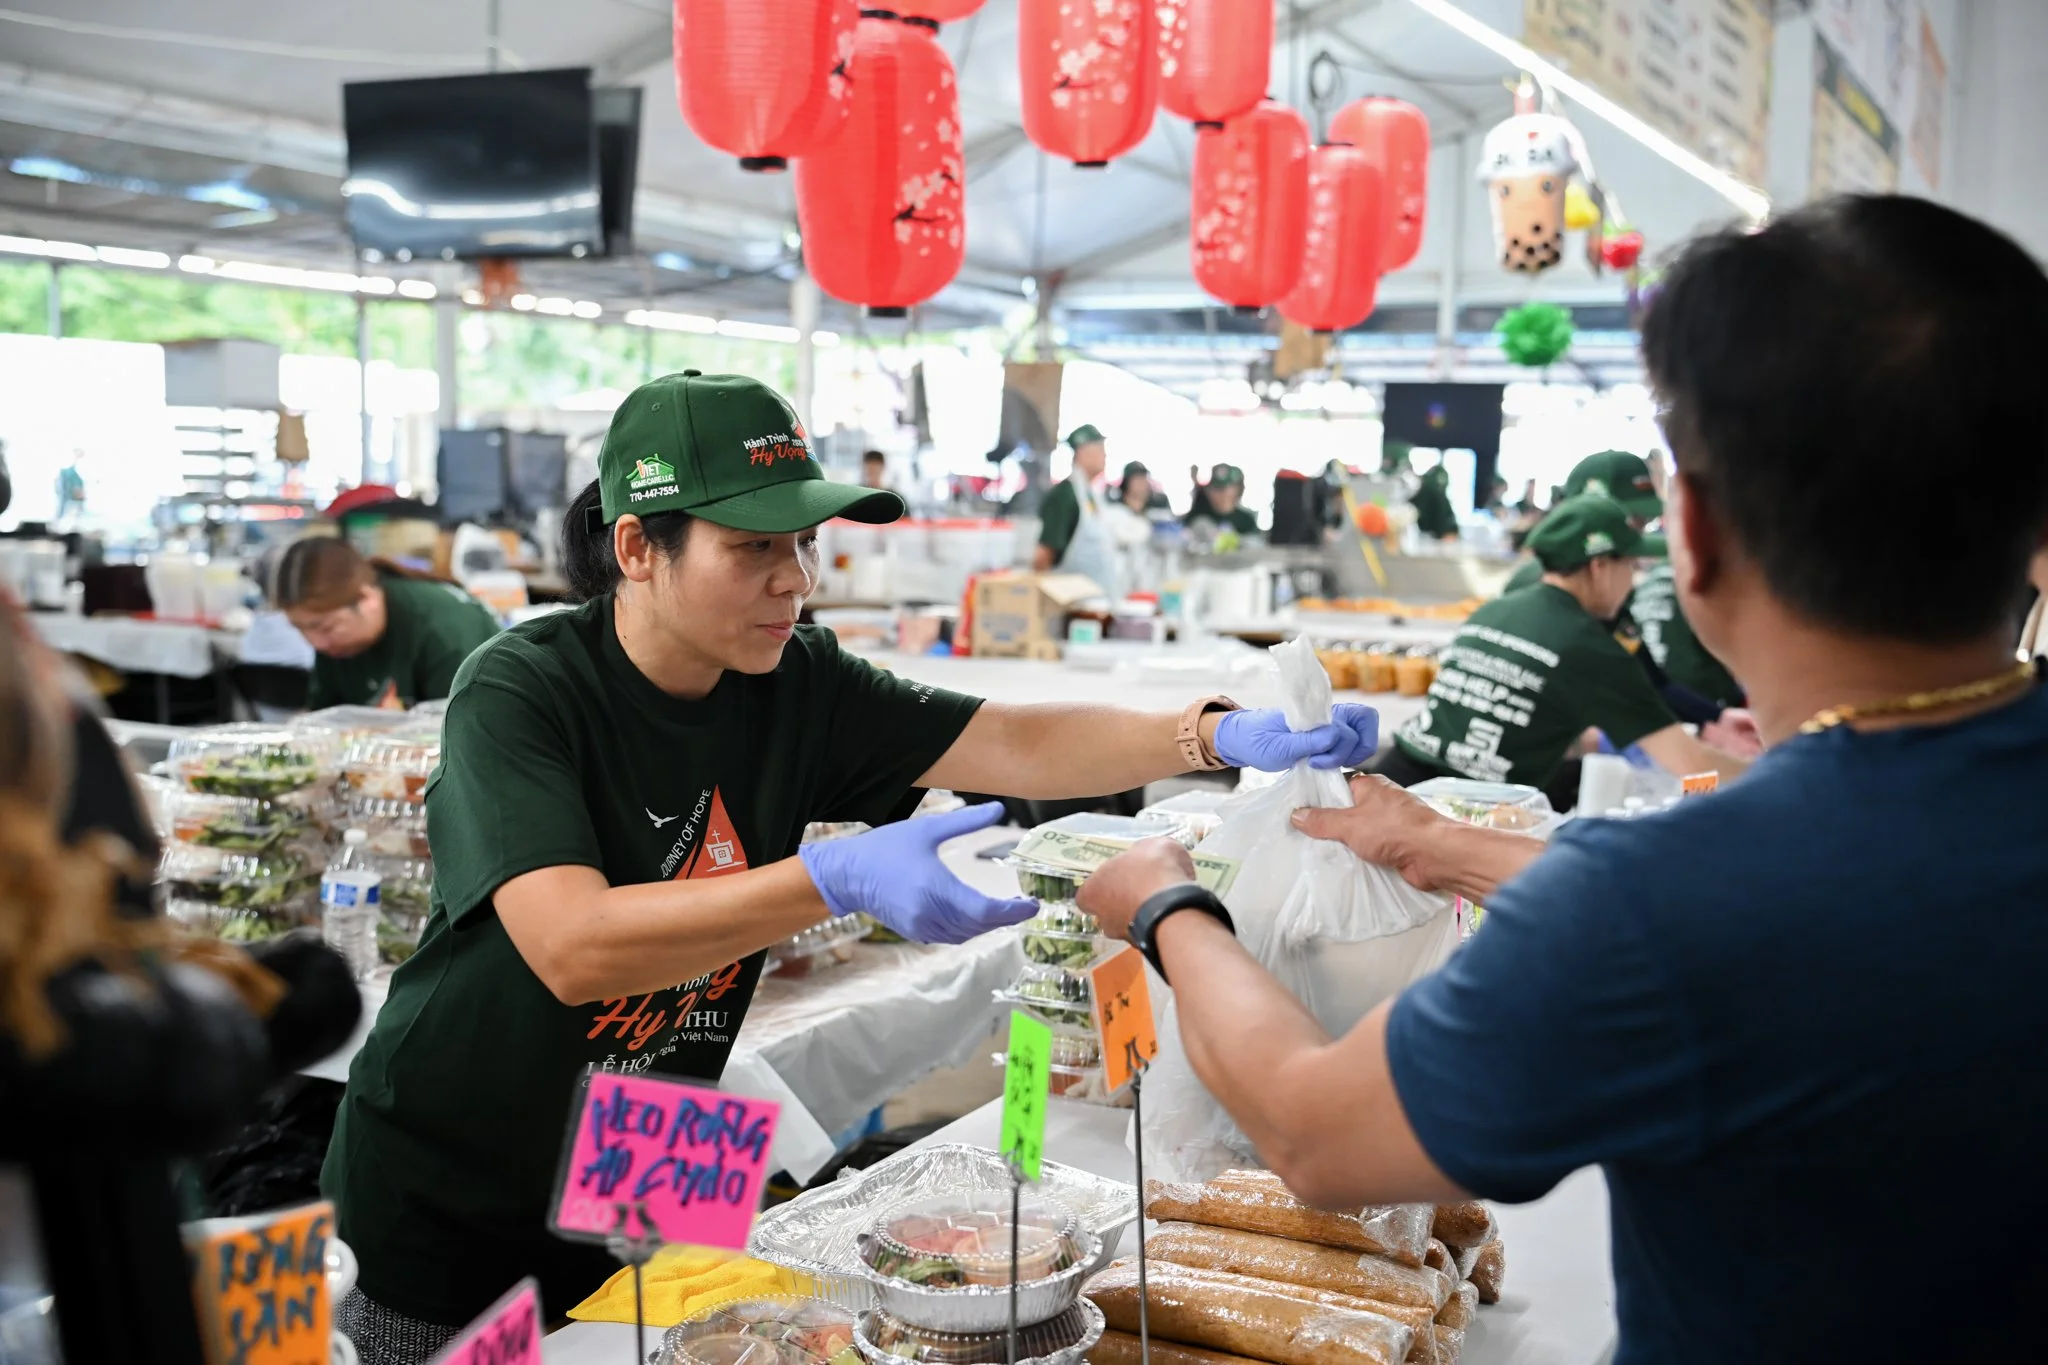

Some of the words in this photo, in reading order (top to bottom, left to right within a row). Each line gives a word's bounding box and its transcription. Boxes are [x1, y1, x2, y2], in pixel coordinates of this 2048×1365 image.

[750, 446, 775, 467] Hy
[636, 459, 660, 478] VIET
[629, 485, 680, 502] 770-447-7554
[660, 838, 687, 878] JOURNEY
[681, 822, 695, 841] OF
[690, 789, 711, 823] HOPE
[1043, 830, 1071, 845] 20
[586, 993, 667, 1051] Hy
[684, 1010, 729, 1028] THU
[681, 1031, 701, 1043] Việt
[704, 1032, 729, 1042] Nam
